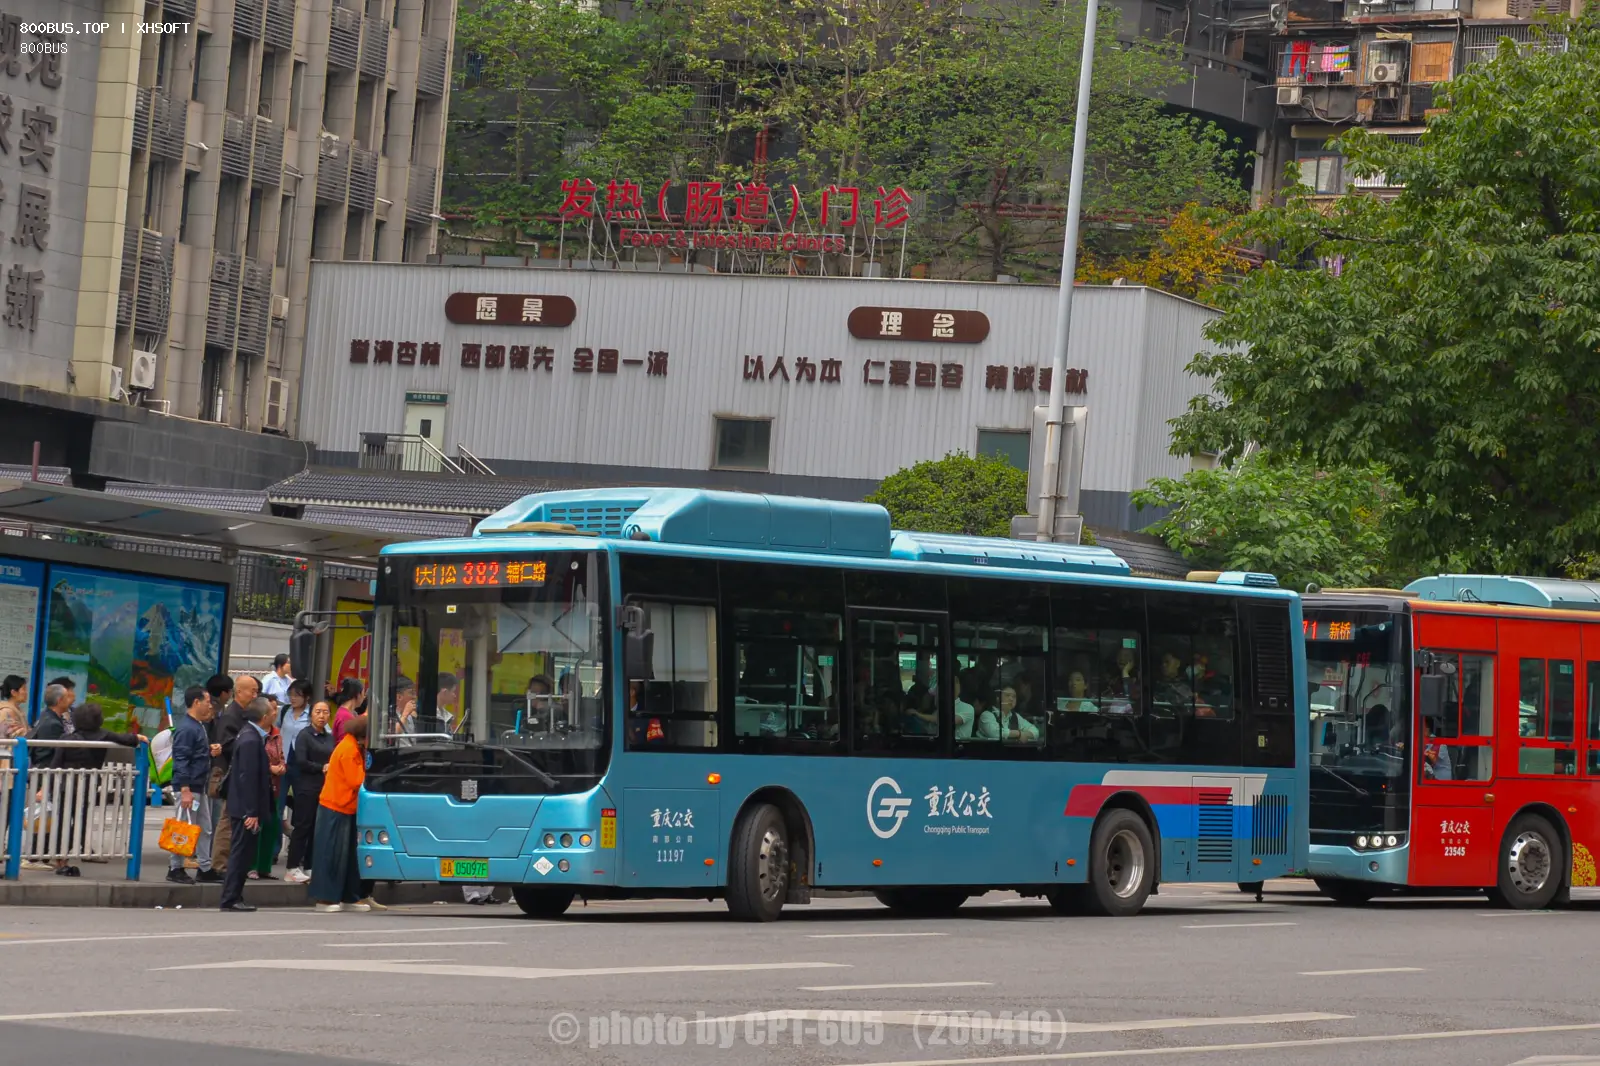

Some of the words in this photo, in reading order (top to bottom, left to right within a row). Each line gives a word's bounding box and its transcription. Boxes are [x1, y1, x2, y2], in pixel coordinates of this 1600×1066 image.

[558, 178, 913, 230] 发热（肠道）门诊
[619, 228, 671, 248] Fever
[674, 229, 688, 248] &
[692, 230, 778, 250] Intestinal
[782, 232, 846, 252] Clinics
[476, 296, 544, 322] 愿景
[879, 311, 955, 338] 理念
[460, 343, 555, 372] 西部领先
[572, 347, 669, 377] 全国一流
[743, 354, 843, 383] 以人为本
[863, 358, 964, 389] 仁爱包容
[462, 562, 499, 585] 382
[1329, 620, 1351, 640] 新桥
[923, 785, 993, 819] 重庆公交
[650, 808, 695, 828] 重庆公交
[1440, 820, 1471, 834] 重庆公交
[923, 825, 951, 835] Chongqing
[951, 825, 967, 834] Public
[967, 825, 990, 836] Transport
[656, 849, 684, 862] 11197
[1444, 846, 1466, 857] 23545
